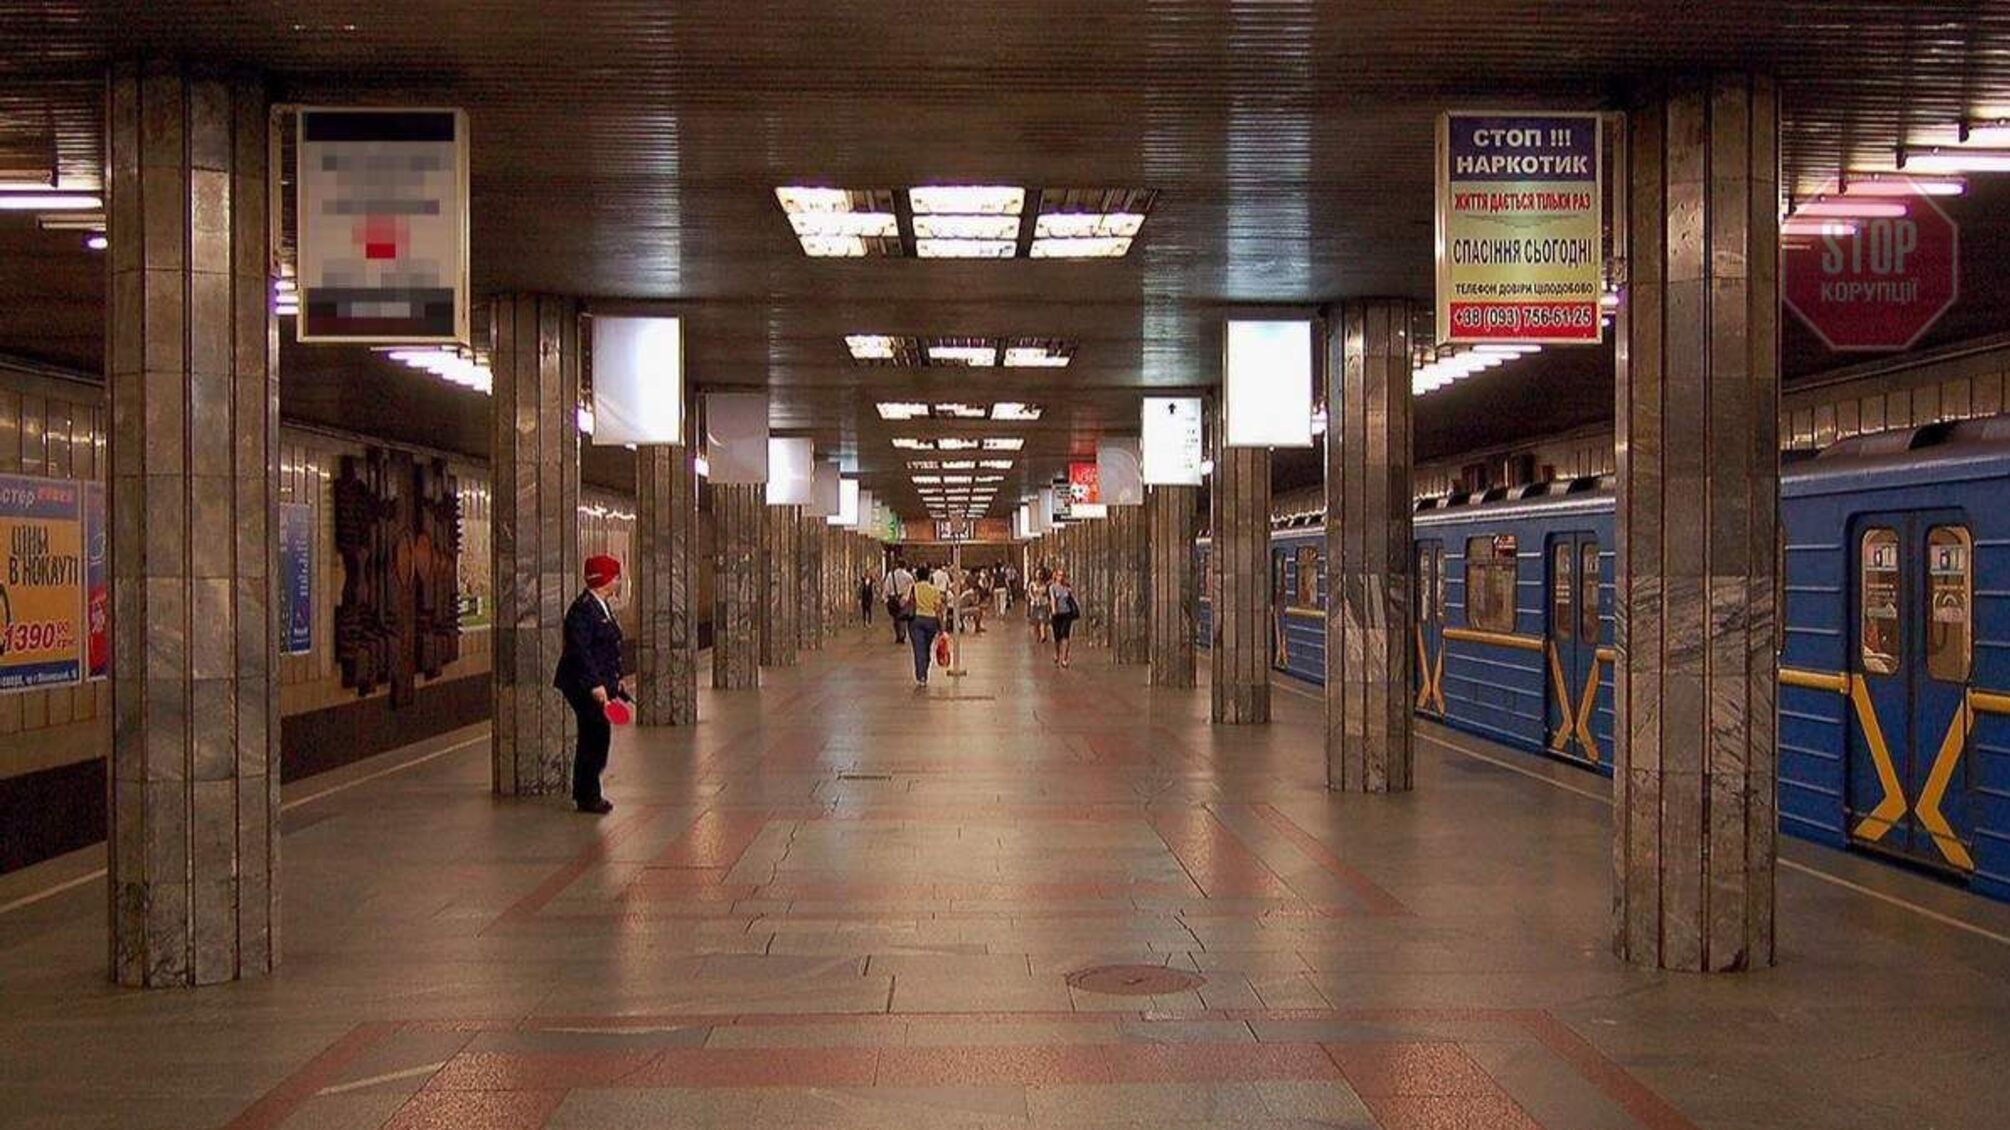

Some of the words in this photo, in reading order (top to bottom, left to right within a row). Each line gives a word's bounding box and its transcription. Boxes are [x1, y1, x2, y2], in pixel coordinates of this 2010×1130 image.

[1473, 129, 1541, 147] СТОП
[1550, 129, 1571, 147] !!!
[1456, 155, 1588, 174] НАРКОТИК
[1454, 192, 1488, 211] ЖИТТЯ
[1489, 192, 1535, 214] ДАЄТЬСЯ
[1535, 192, 1571, 211] ТІЛЬКИ
[1572, 192, 1591, 211] РАЗ
[1453, 239, 1521, 264] СПАСІННЯ
[1523, 238, 1592, 269] СЬОГОДНІ
[1455, 282, 1497, 296] ТЕЛЕФОН
[1498, 282, 1533, 297] ДОВІРИ
[1533, 282, 1594, 297] ЦІЛОДОБОВО
[1455, 306, 1481, 327] +38
[1483, 306, 1520, 332] (093)
[1522, 306, 1592, 328] 756-61-25
[0, 487, 35, 509] стер
[9, 557, 19, 586] В
[23, 555, 79, 586] НОКАУТІ
[4, 621, 55, 652] 1390
